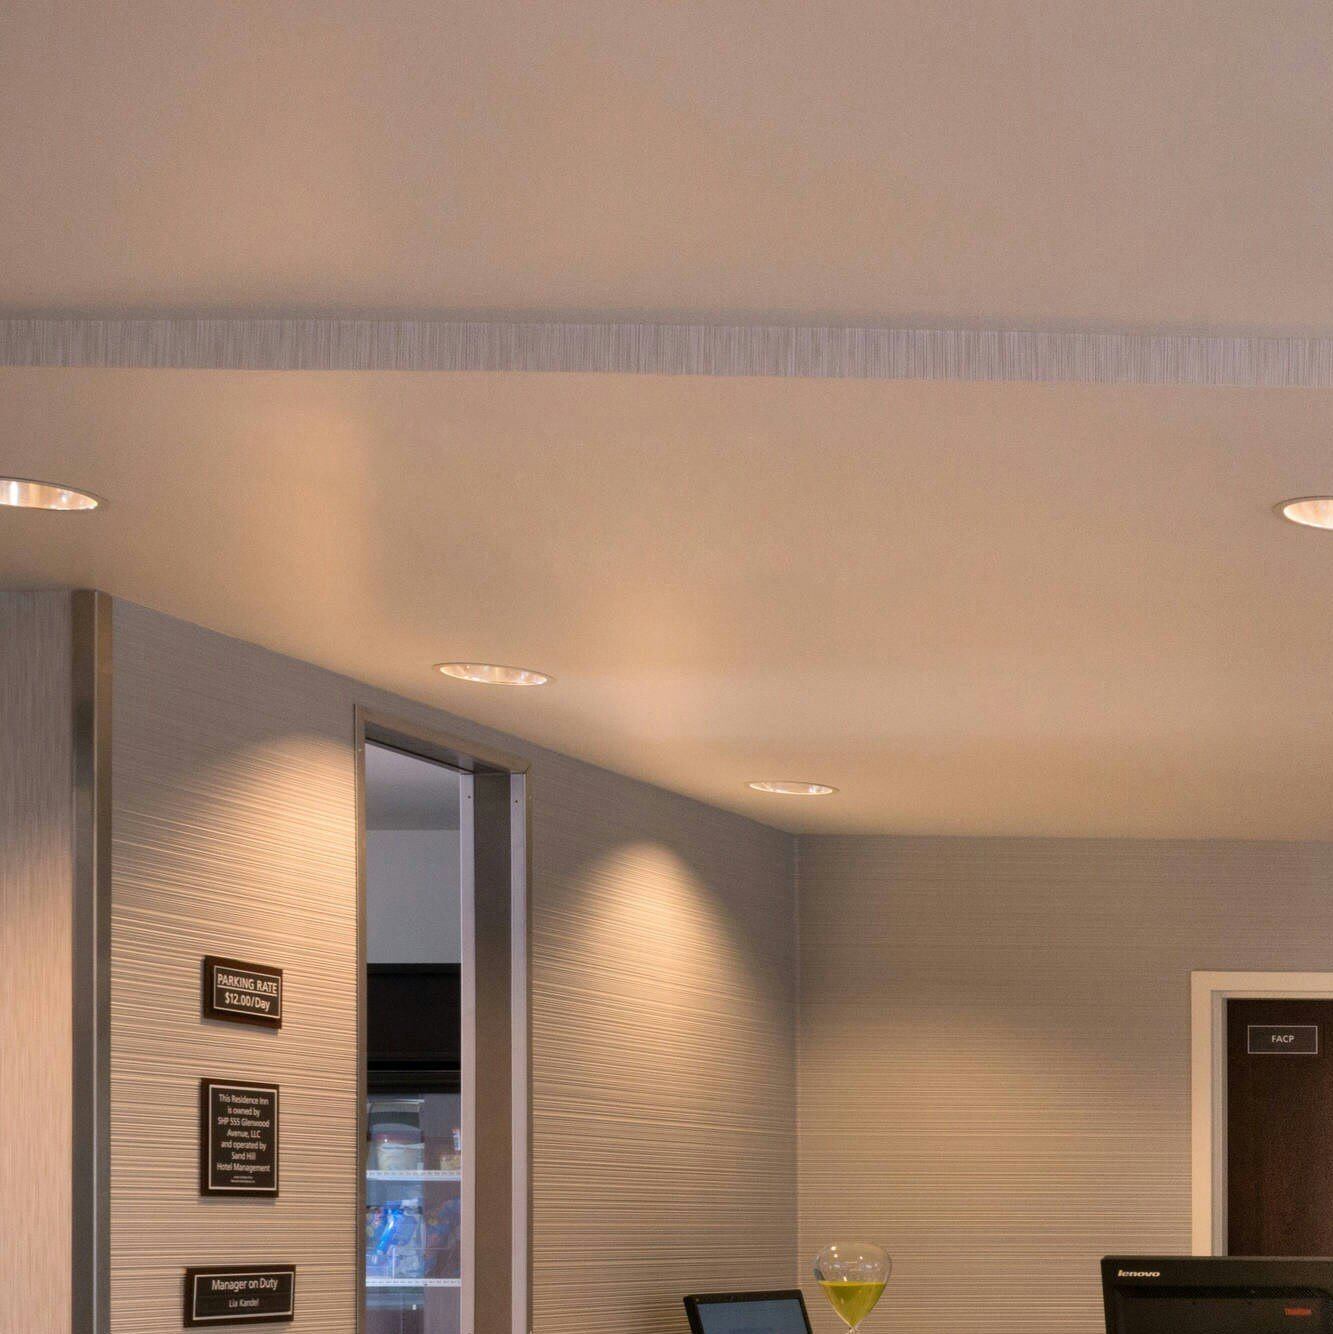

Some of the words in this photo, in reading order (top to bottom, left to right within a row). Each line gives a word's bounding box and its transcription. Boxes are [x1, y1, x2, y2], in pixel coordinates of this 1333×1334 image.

[217, 973, 255, 990] PARKING
[256, 980, 278, 994] RATE
[224, 991, 271, 1012] $12.00/Day
[1271, 1034, 1295, 1043] FACP
[218, 1093, 231, 1103] This
[231, 1095, 259, 1105] Residence
[259, 1097, 270, 1105] Inn
[232, 1107, 253, 1116] owned
[253, 1107, 261, 1118] by
[221, 1140, 232, 1148] and
[232, 1141, 258, 1150] operated
[258, 1141, 267, 1152] by
[216, 1162, 233, 1171] Hotel
[233, 1163, 271, 1173] Management
[1117, 1269, 1161, 1277] lenovo
[211, 1279, 247, 1292] Manager
[248, 1280, 258, 1289] on
[259, 1277, 278, 1291] Duty
